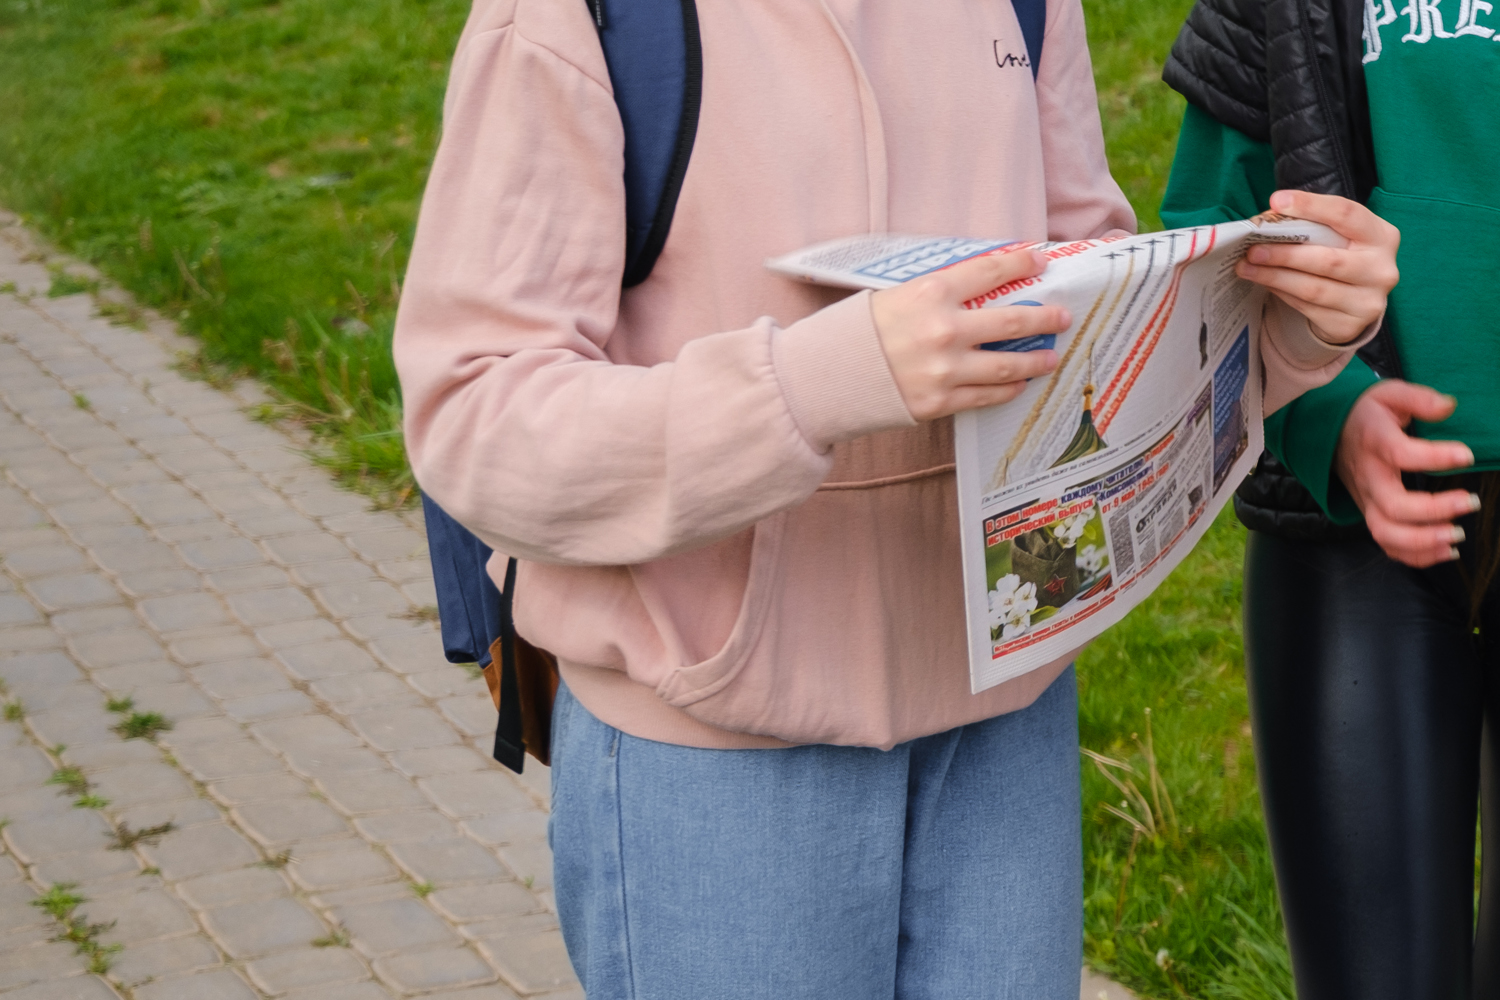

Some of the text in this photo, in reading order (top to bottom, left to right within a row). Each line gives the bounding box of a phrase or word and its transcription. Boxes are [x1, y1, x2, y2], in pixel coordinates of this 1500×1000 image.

[985, 519, 995, 533] В
[996, 513, 1020, 530] этом
[1021, 497, 1059, 519] номере
[1061, 480, 1104, 505] каждому
[987, 511, 1056, 546] исторический
[1058, 499, 1094, 523] выпуск
